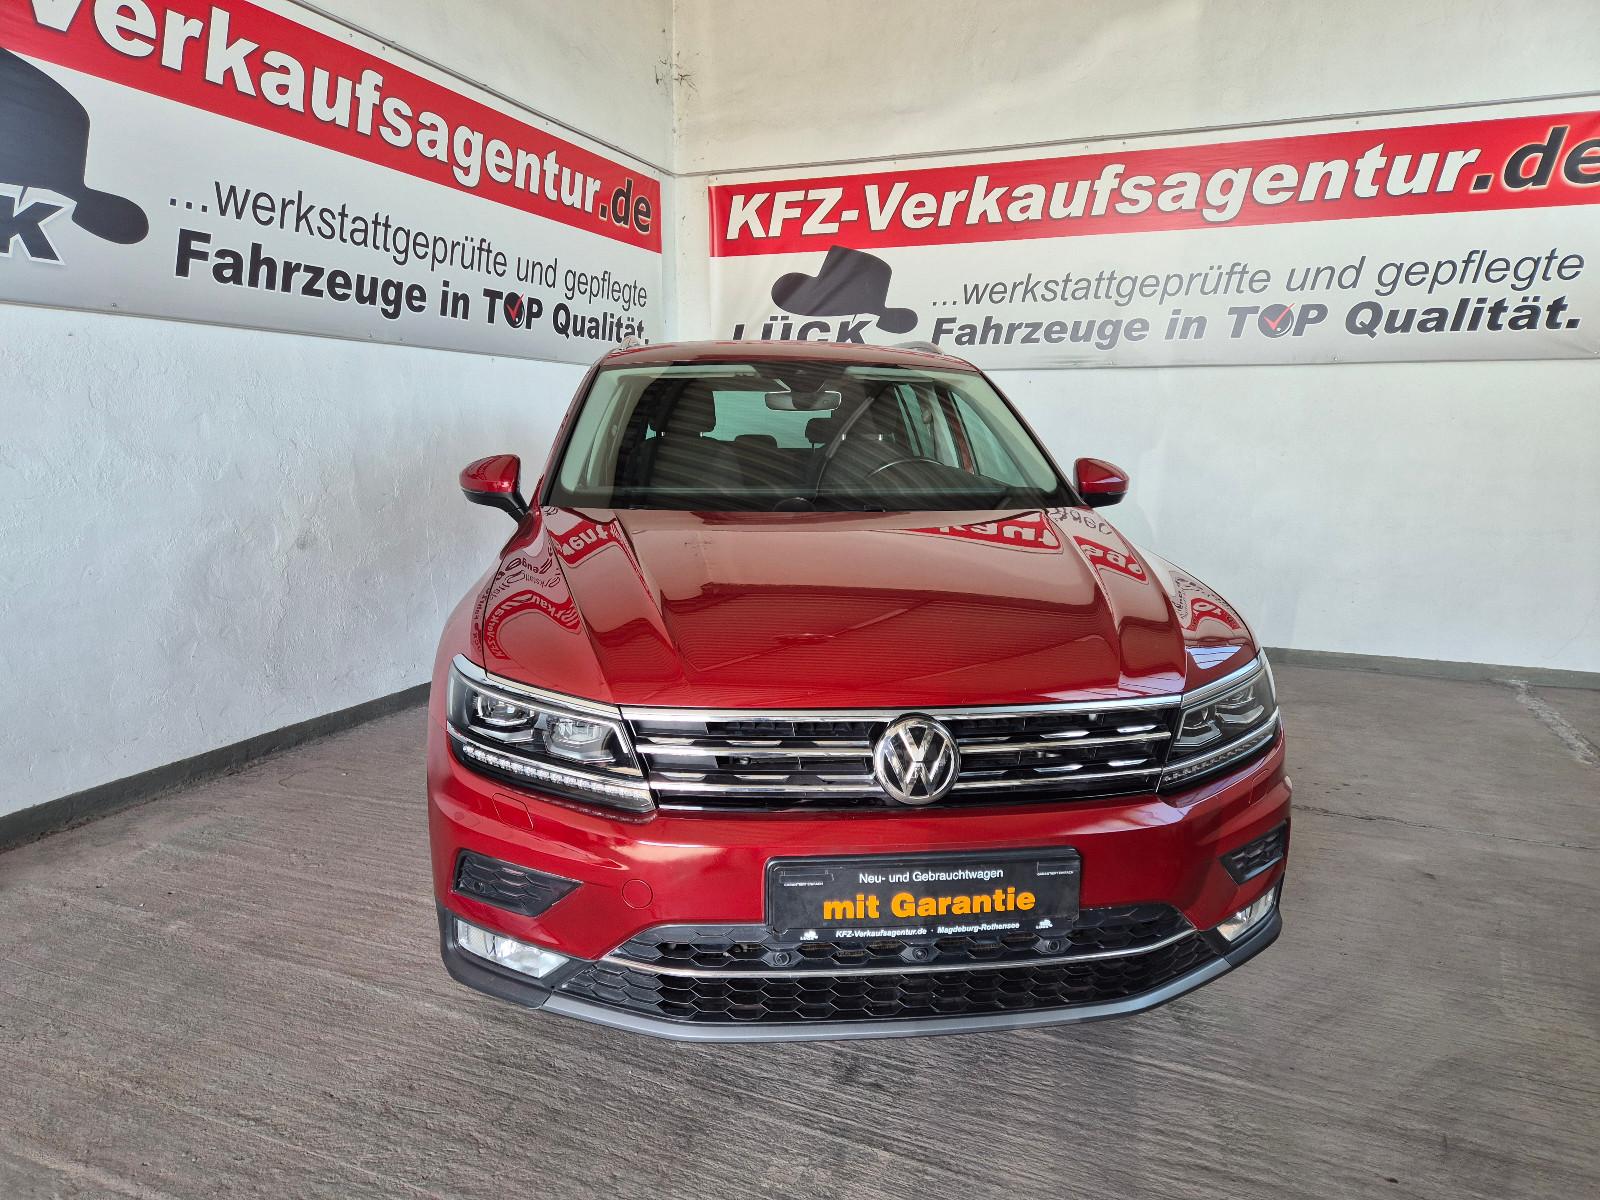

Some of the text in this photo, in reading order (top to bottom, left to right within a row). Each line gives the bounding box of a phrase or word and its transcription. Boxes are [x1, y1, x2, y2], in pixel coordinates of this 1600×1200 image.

[726, 124, 1600, 241] KFZ-Verkaufsagentur.de
[168, 180, 648, 312] ...werkstattgeprüfte und gepflegte
[174, 228, 649, 345] Fahrzeuge in TOP Qualität.
[932, 248, 1585, 307] ...werkstattgeprüfte und gepflegte
[931, 294, 1581, 351] Fahrzeuge in TOP Qualität.
[823, 887, 1036, 920] mit Garantie
[859, 869, 1004, 884] Neu- und Gebrauchtwagen
